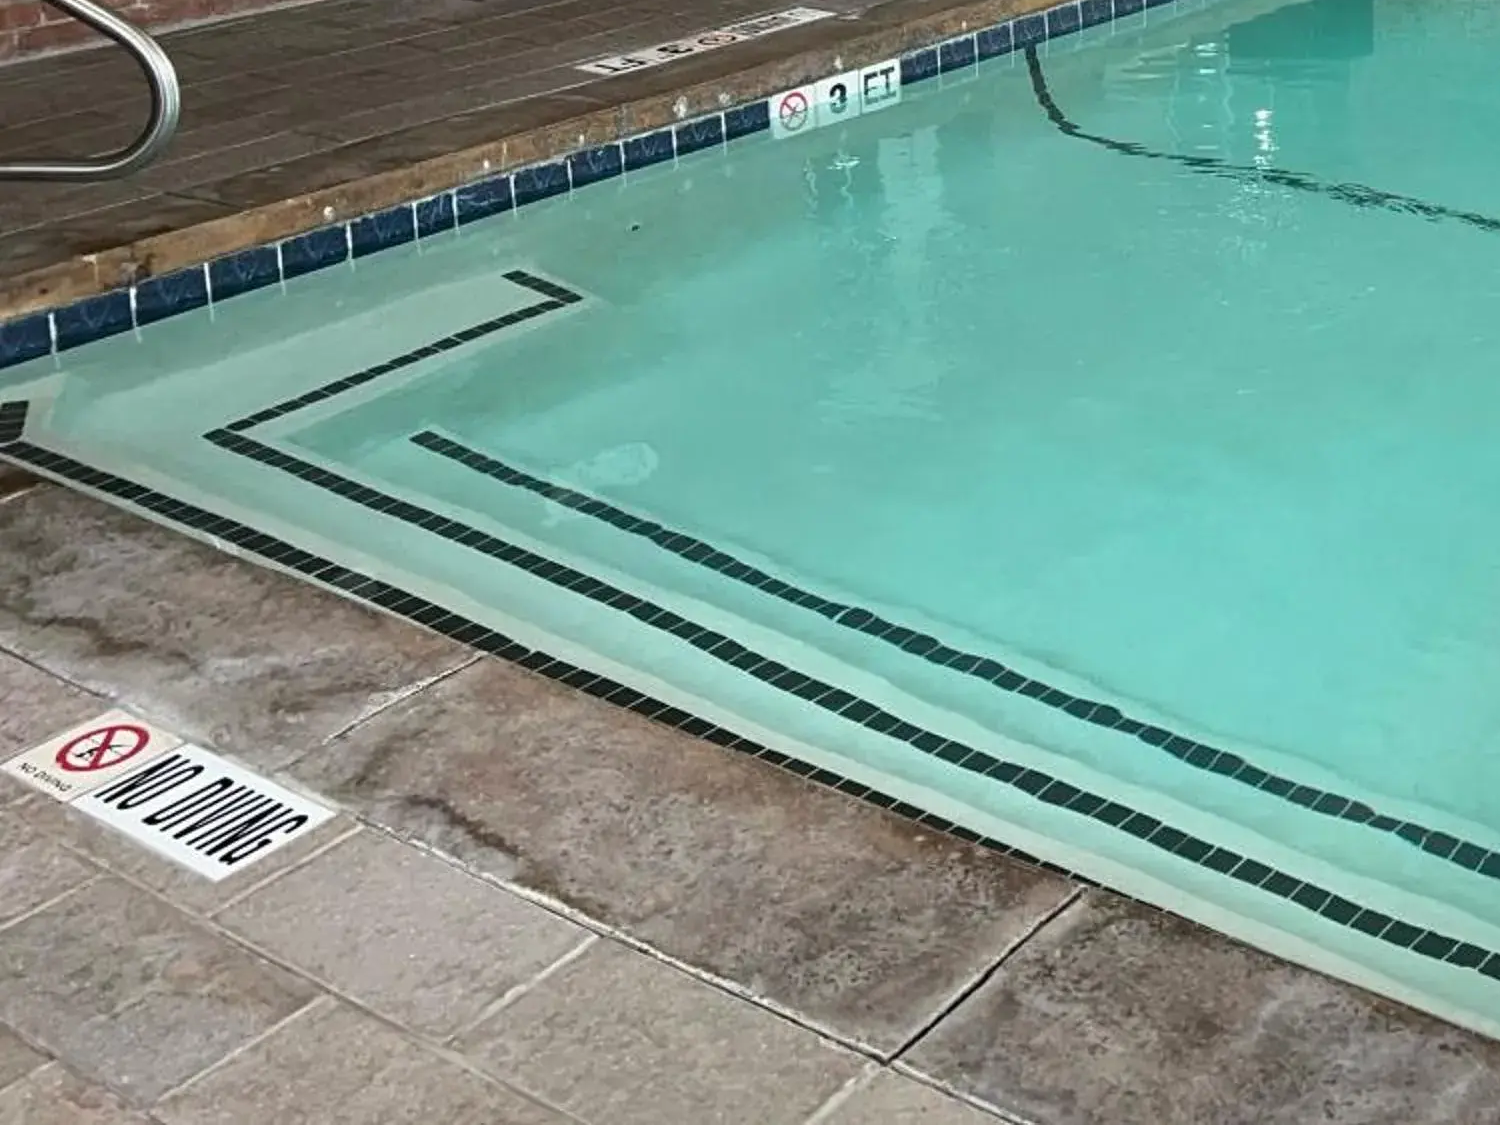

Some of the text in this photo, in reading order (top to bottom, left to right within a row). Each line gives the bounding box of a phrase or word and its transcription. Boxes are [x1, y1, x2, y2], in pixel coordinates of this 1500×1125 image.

[829, 66, 896, 114] 3 FT
[17, 762, 73, 792] NO DIVING
[94, 754, 309, 865] NO DIVING
